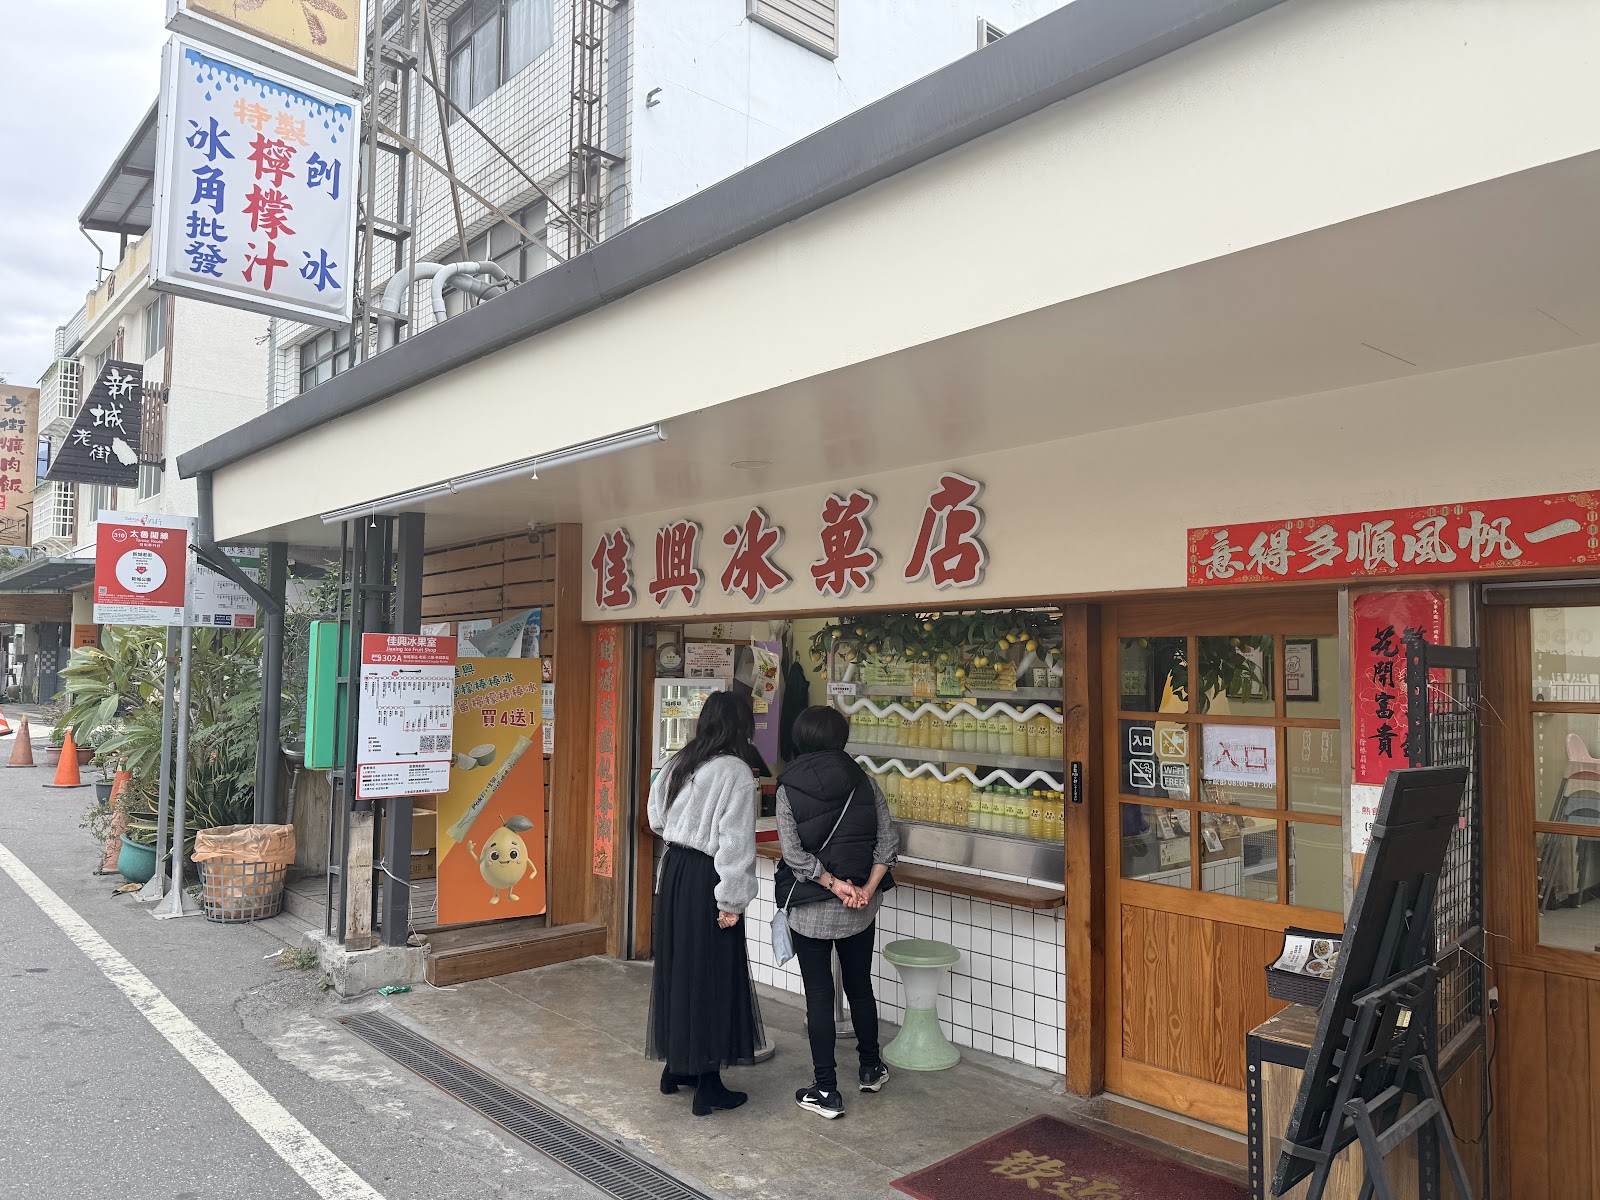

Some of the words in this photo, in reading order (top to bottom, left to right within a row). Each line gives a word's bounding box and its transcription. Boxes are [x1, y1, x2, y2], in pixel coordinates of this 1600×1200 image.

[233, 97, 310, 147] 特製
[184, 116, 236, 279] 冰角批發
[241, 132, 297, 292] 檸檬汁
[299, 150, 343, 293] 刨冰
[89, 368, 140, 435] 新城
[71, 428, 112, 465] 老街
[591, 472, 988, 610] 佳興冰菓店
[382, 654, 403, 662] 302A
[386, 635, 437, 648] 佳興冰果室
[1368, 624, 1399, 759] 花開富貴
[481, 708, 535, 727] 買4送1
[1131, 734, 1152, 747] 入口
[1213, 741, 1268, 772] 入口
[1163, 765, 1184, 775] Wi-Fi
[1164, 777, 1184, 787] FREE
